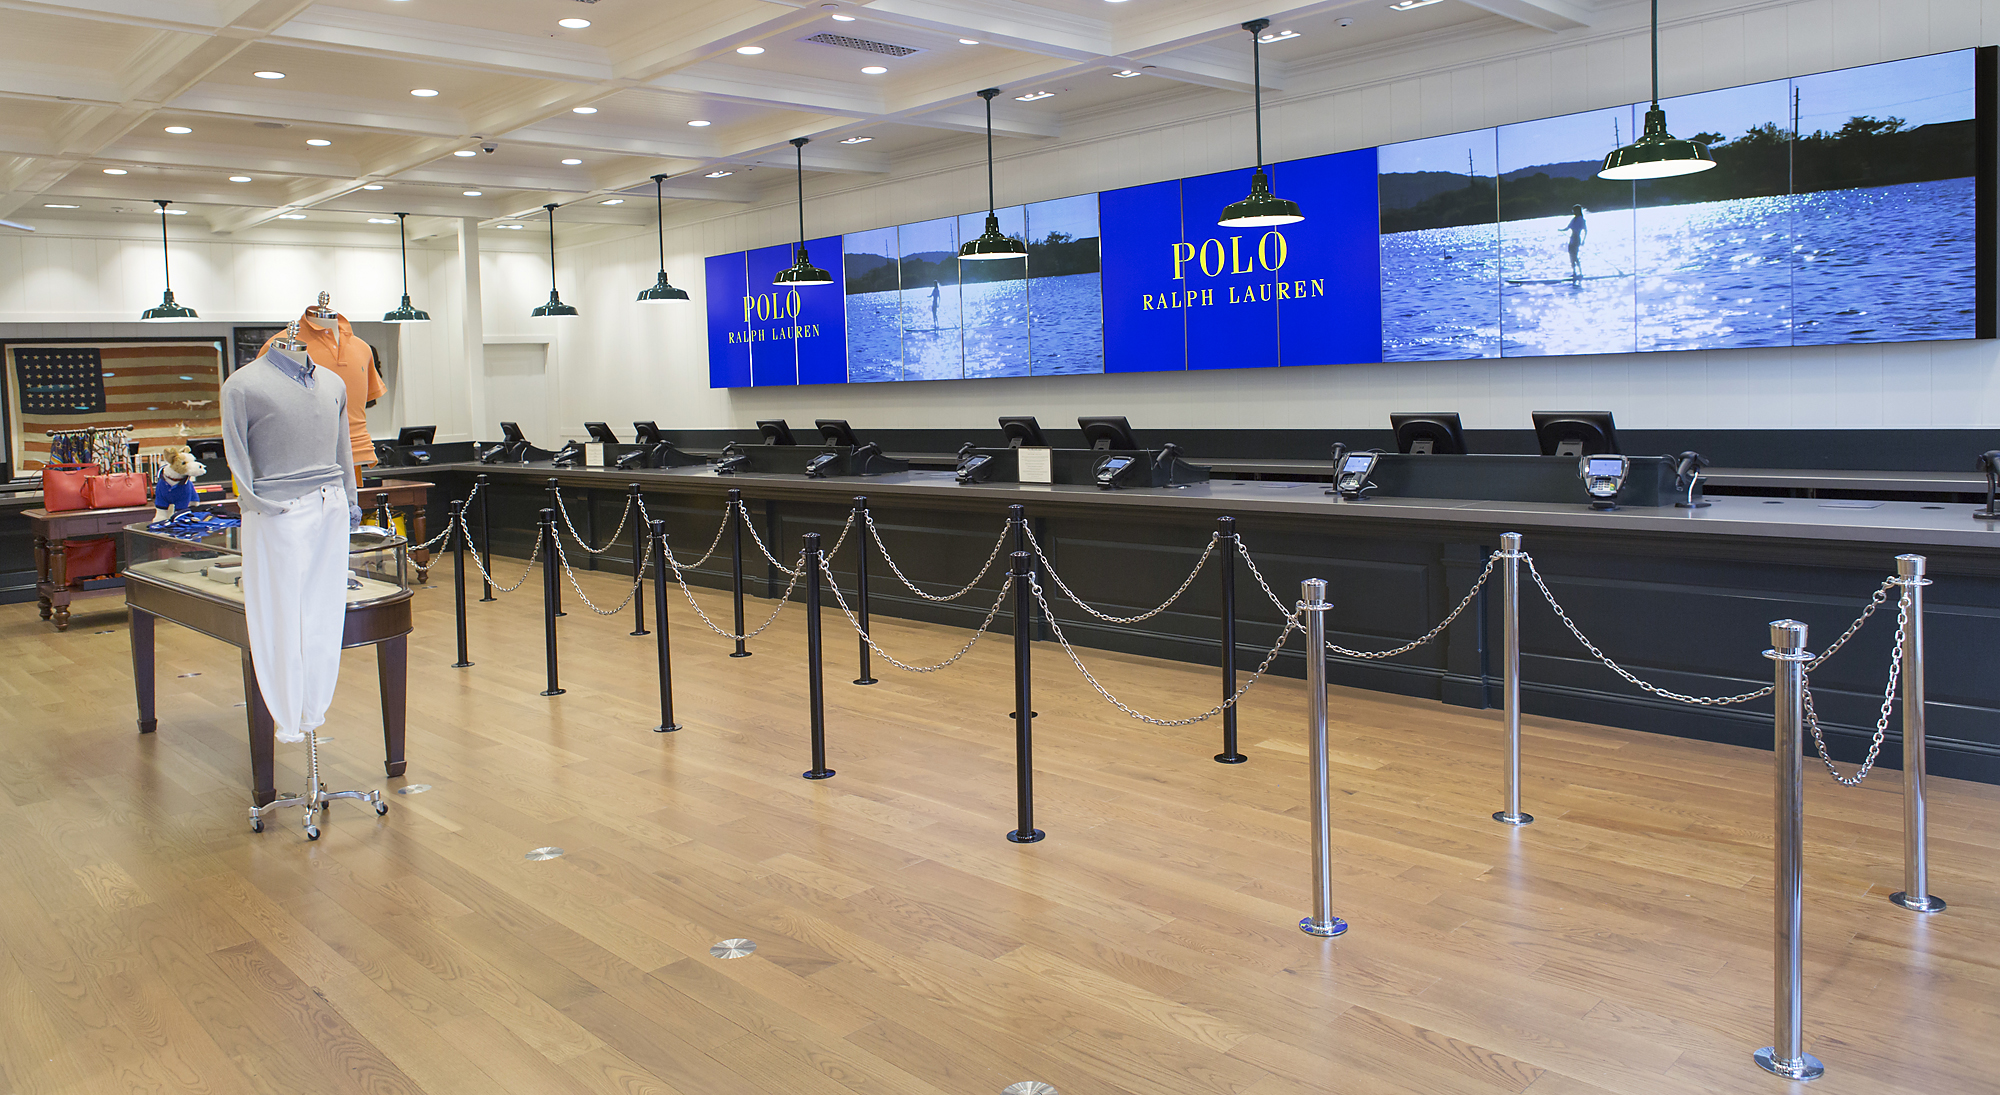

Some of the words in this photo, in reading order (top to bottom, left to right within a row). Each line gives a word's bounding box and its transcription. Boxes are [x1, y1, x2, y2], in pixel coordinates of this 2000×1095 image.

[1172, 231, 1288, 280] POLO
[743, 289, 801, 322] POLO
[1143, 288, 1214, 311] RALPH
[1229, 278, 1325, 304] LAUREN
[728, 329, 765, 344] RALPH
[772, 324, 820, 341] LAUREN
